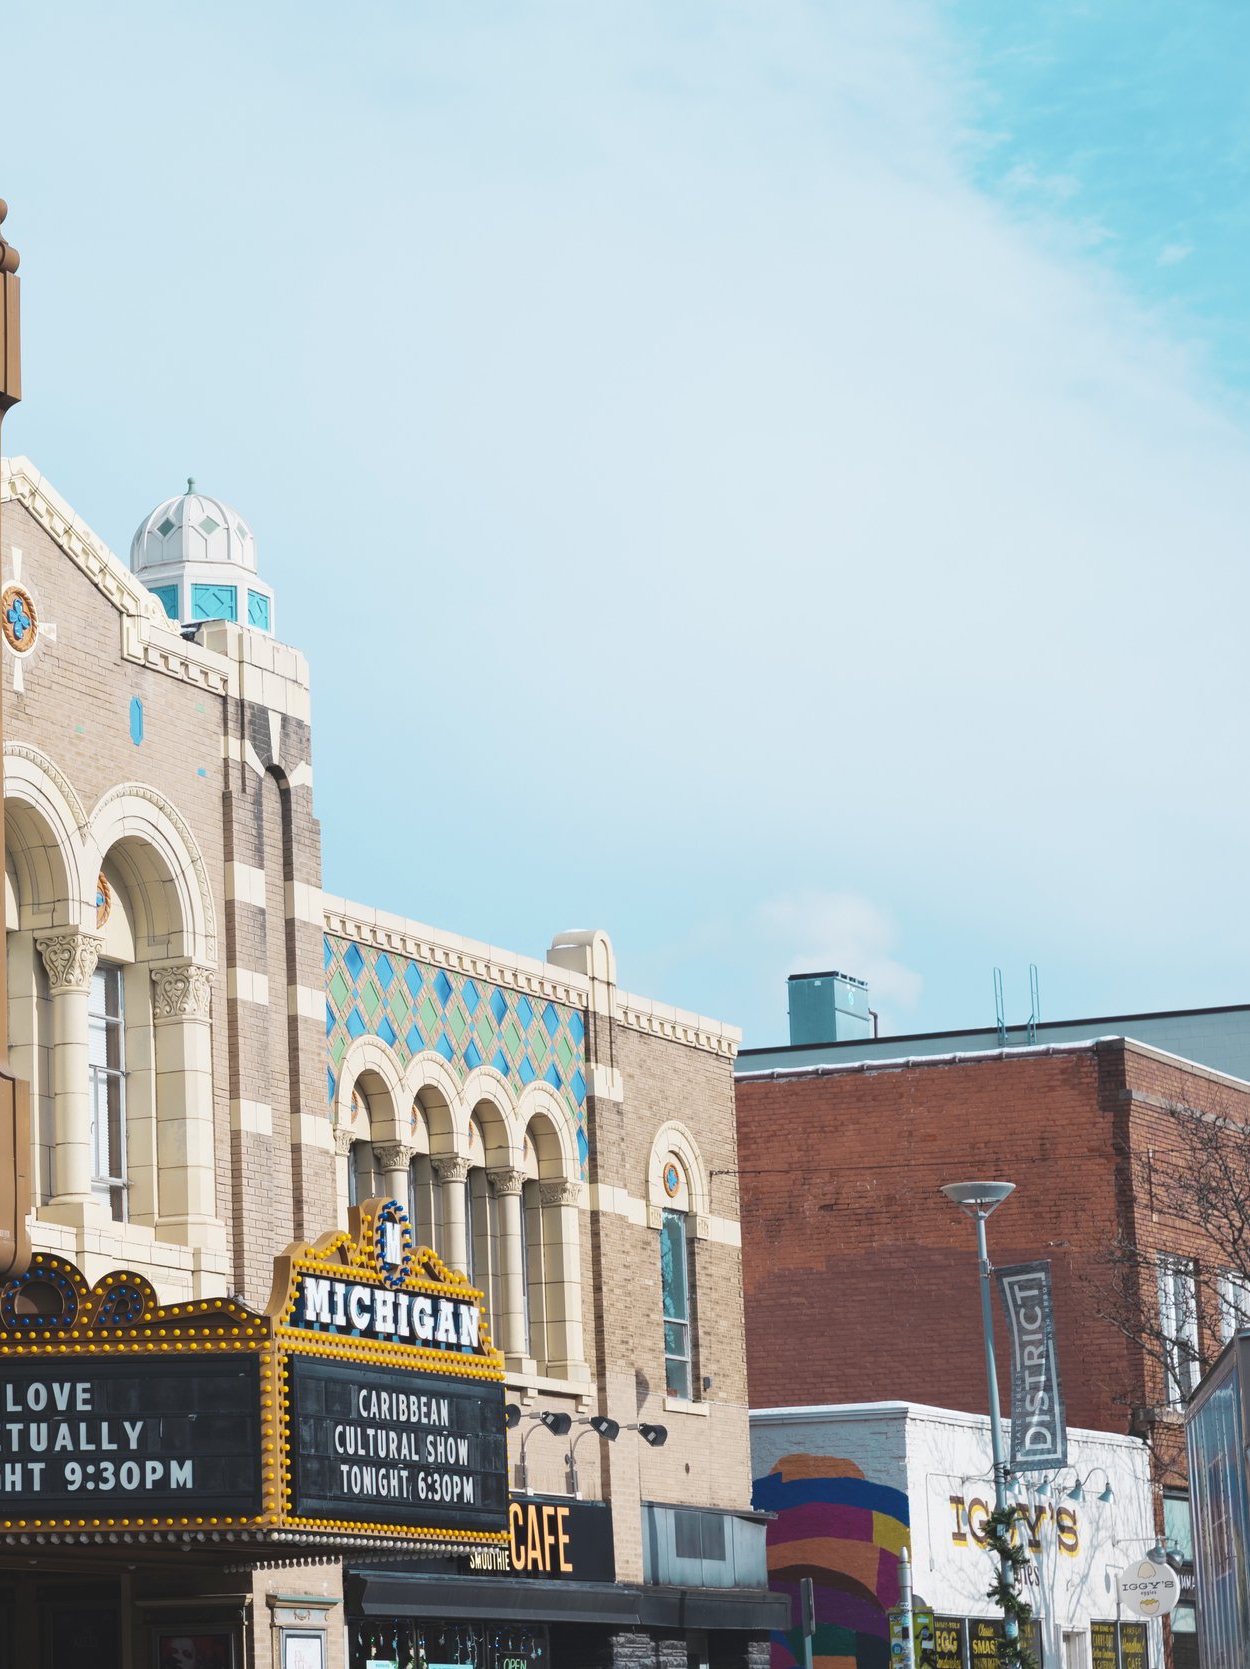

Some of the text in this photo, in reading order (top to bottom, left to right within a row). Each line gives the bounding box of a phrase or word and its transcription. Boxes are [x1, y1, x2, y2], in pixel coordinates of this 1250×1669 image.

[302, 1276, 480, 1347] MICHIGAN
[1014, 1284, 1052, 1450] DISTRICT
[6, 1382, 92, 1412] LOVE
[358, 1389, 449, 1426] CARIBBEAN
[334, 1425, 469, 1466] CULTURAL SHOW
[1015, 1419, 1023, 1451] STATE
[64, 1459, 194, 1492] 9:30PM
[340, 1464, 474, 1504] TONIGHT 6:30PM
[508, 1502, 573, 1572] CAFE
[950, 1495, 1080, 1558] IGY'S
[1122, 1580, 1174, 1591] IGGY'S
[935, 1631, 959, 1654] EGG
